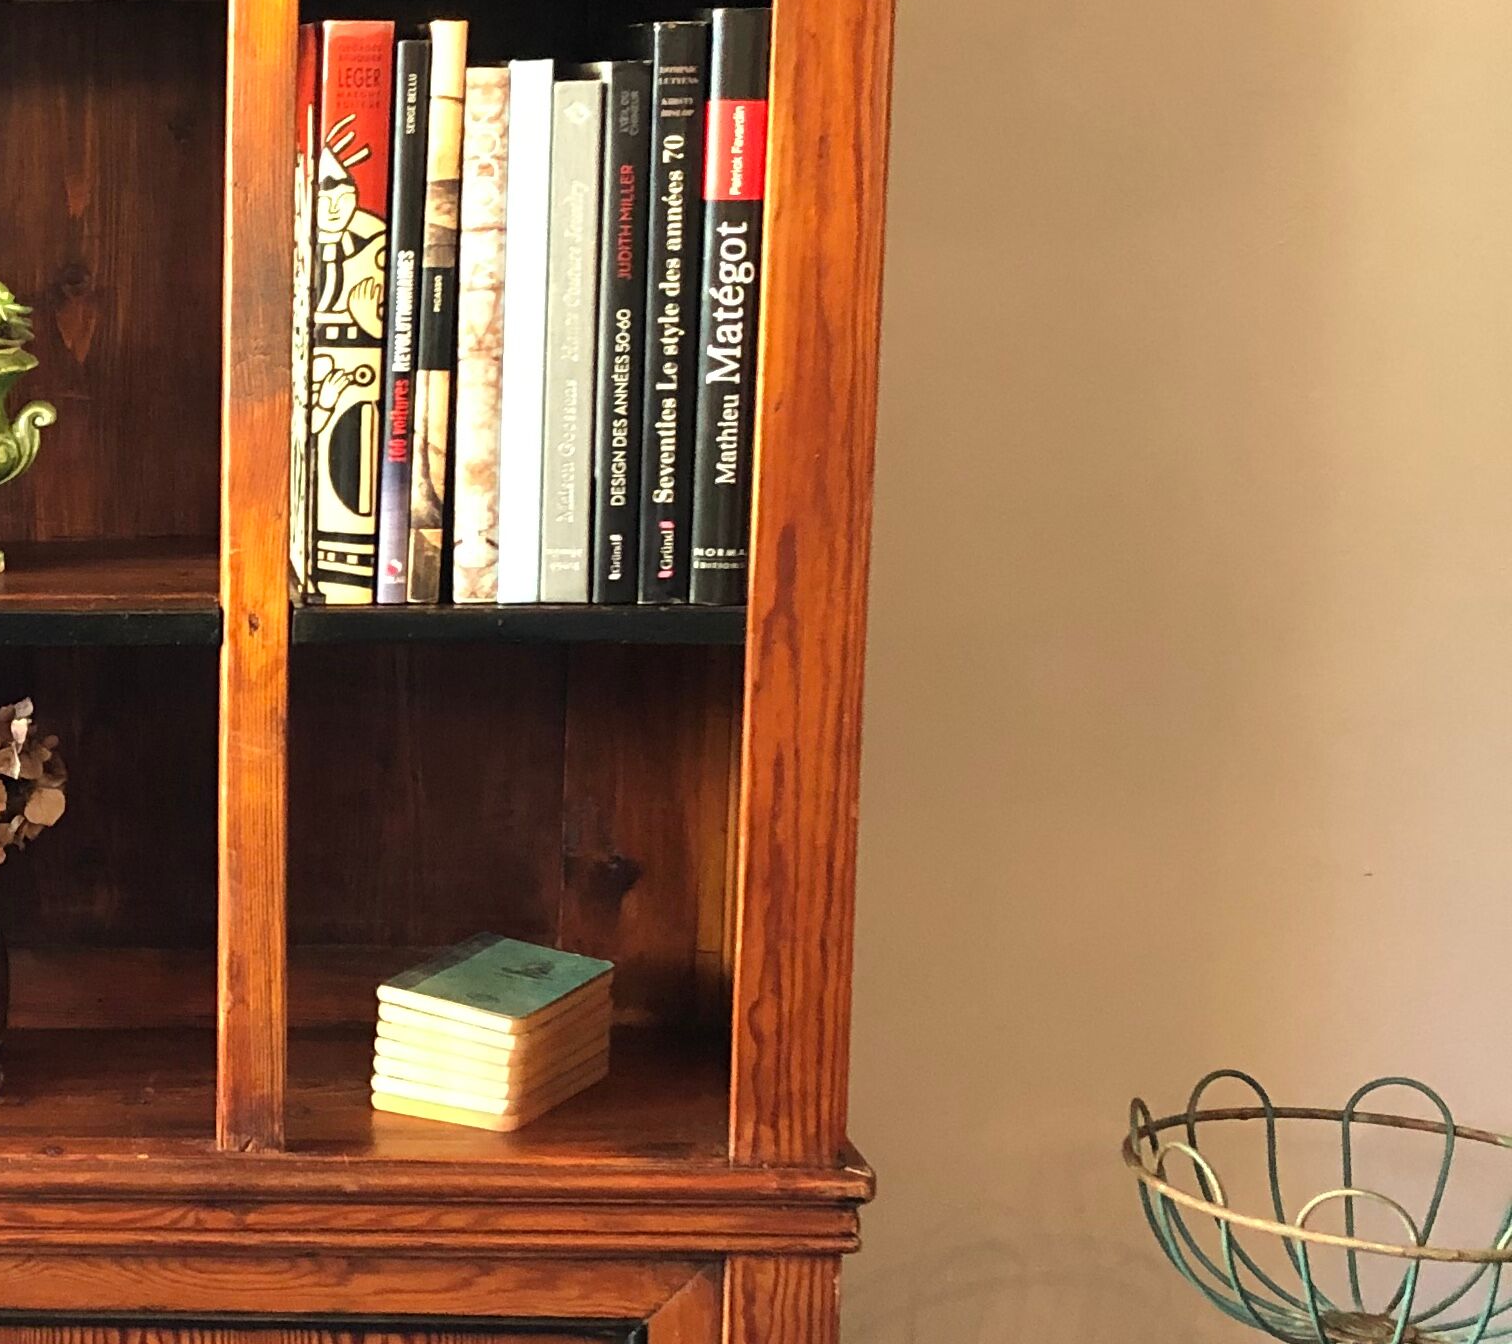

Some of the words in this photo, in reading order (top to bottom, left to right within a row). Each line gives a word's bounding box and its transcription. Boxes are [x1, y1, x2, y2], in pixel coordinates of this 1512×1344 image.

[338, 67, 382, 88] LEGER
[406, 73, 419, 105] BELLU
[405, 105, 417, 135] SERGE
[730, 105, 746, 156] Favardin
[662, 134, 685, 164] 70
[619, 163, 636, 221] MILLER
[728, 155, 743, 196] Patrick
[661, 169, 684, 252] années
[617, 222, 633, 281] JUDITH
[433, 275, 443, 313] PICASSO
[658, 257, 682, 298] des
[705, 220, 756, 386] Matégot
[614, 308, 632, 351] 50-60
[656, 302, 686, 356] style
[610, 351, 630, 416] ANNÉES
[655, 361, 679, 391] Le
[390, 378, 410, 436] voitures
[388, 436, 408, 463] 100
[611, 418, 629, 448] DES
[651, 397, 678, 504] Seventies
[714, 392, 740, 486] Mathieu
[609, 450, 627, 507] DESIGN
[658, 529, 675, 570] Gründ
